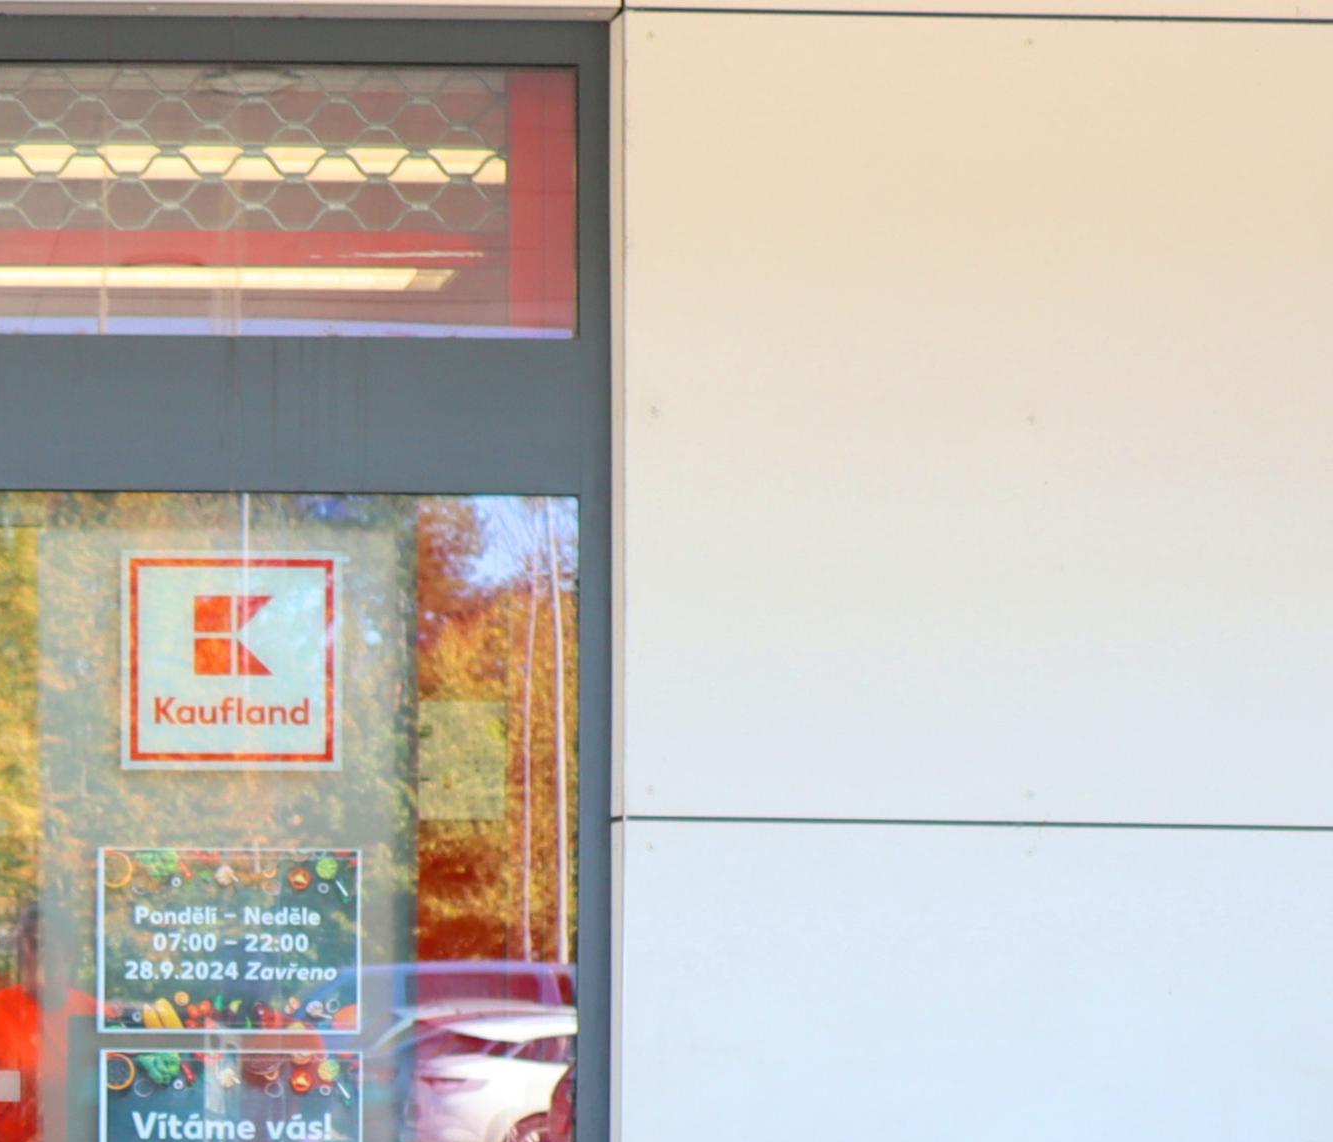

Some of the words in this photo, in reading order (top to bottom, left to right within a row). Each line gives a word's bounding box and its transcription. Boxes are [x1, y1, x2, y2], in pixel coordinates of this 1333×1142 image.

[154, 696, 310, 725] Kaufland
[134, 905, 217, 926] Pondělí
[244, 906, 321, 926] Neděle
[152, 933, 217, 952] 07:00
[244, 933, 309, 952] 22:00
[124, 960, 239, 980] 28.9.2024
[244, 962, 337, 981] Zavřeno
[132, 1111, 256, 1140] Vítáme
[265, 1112, 332, 1140] vás!
